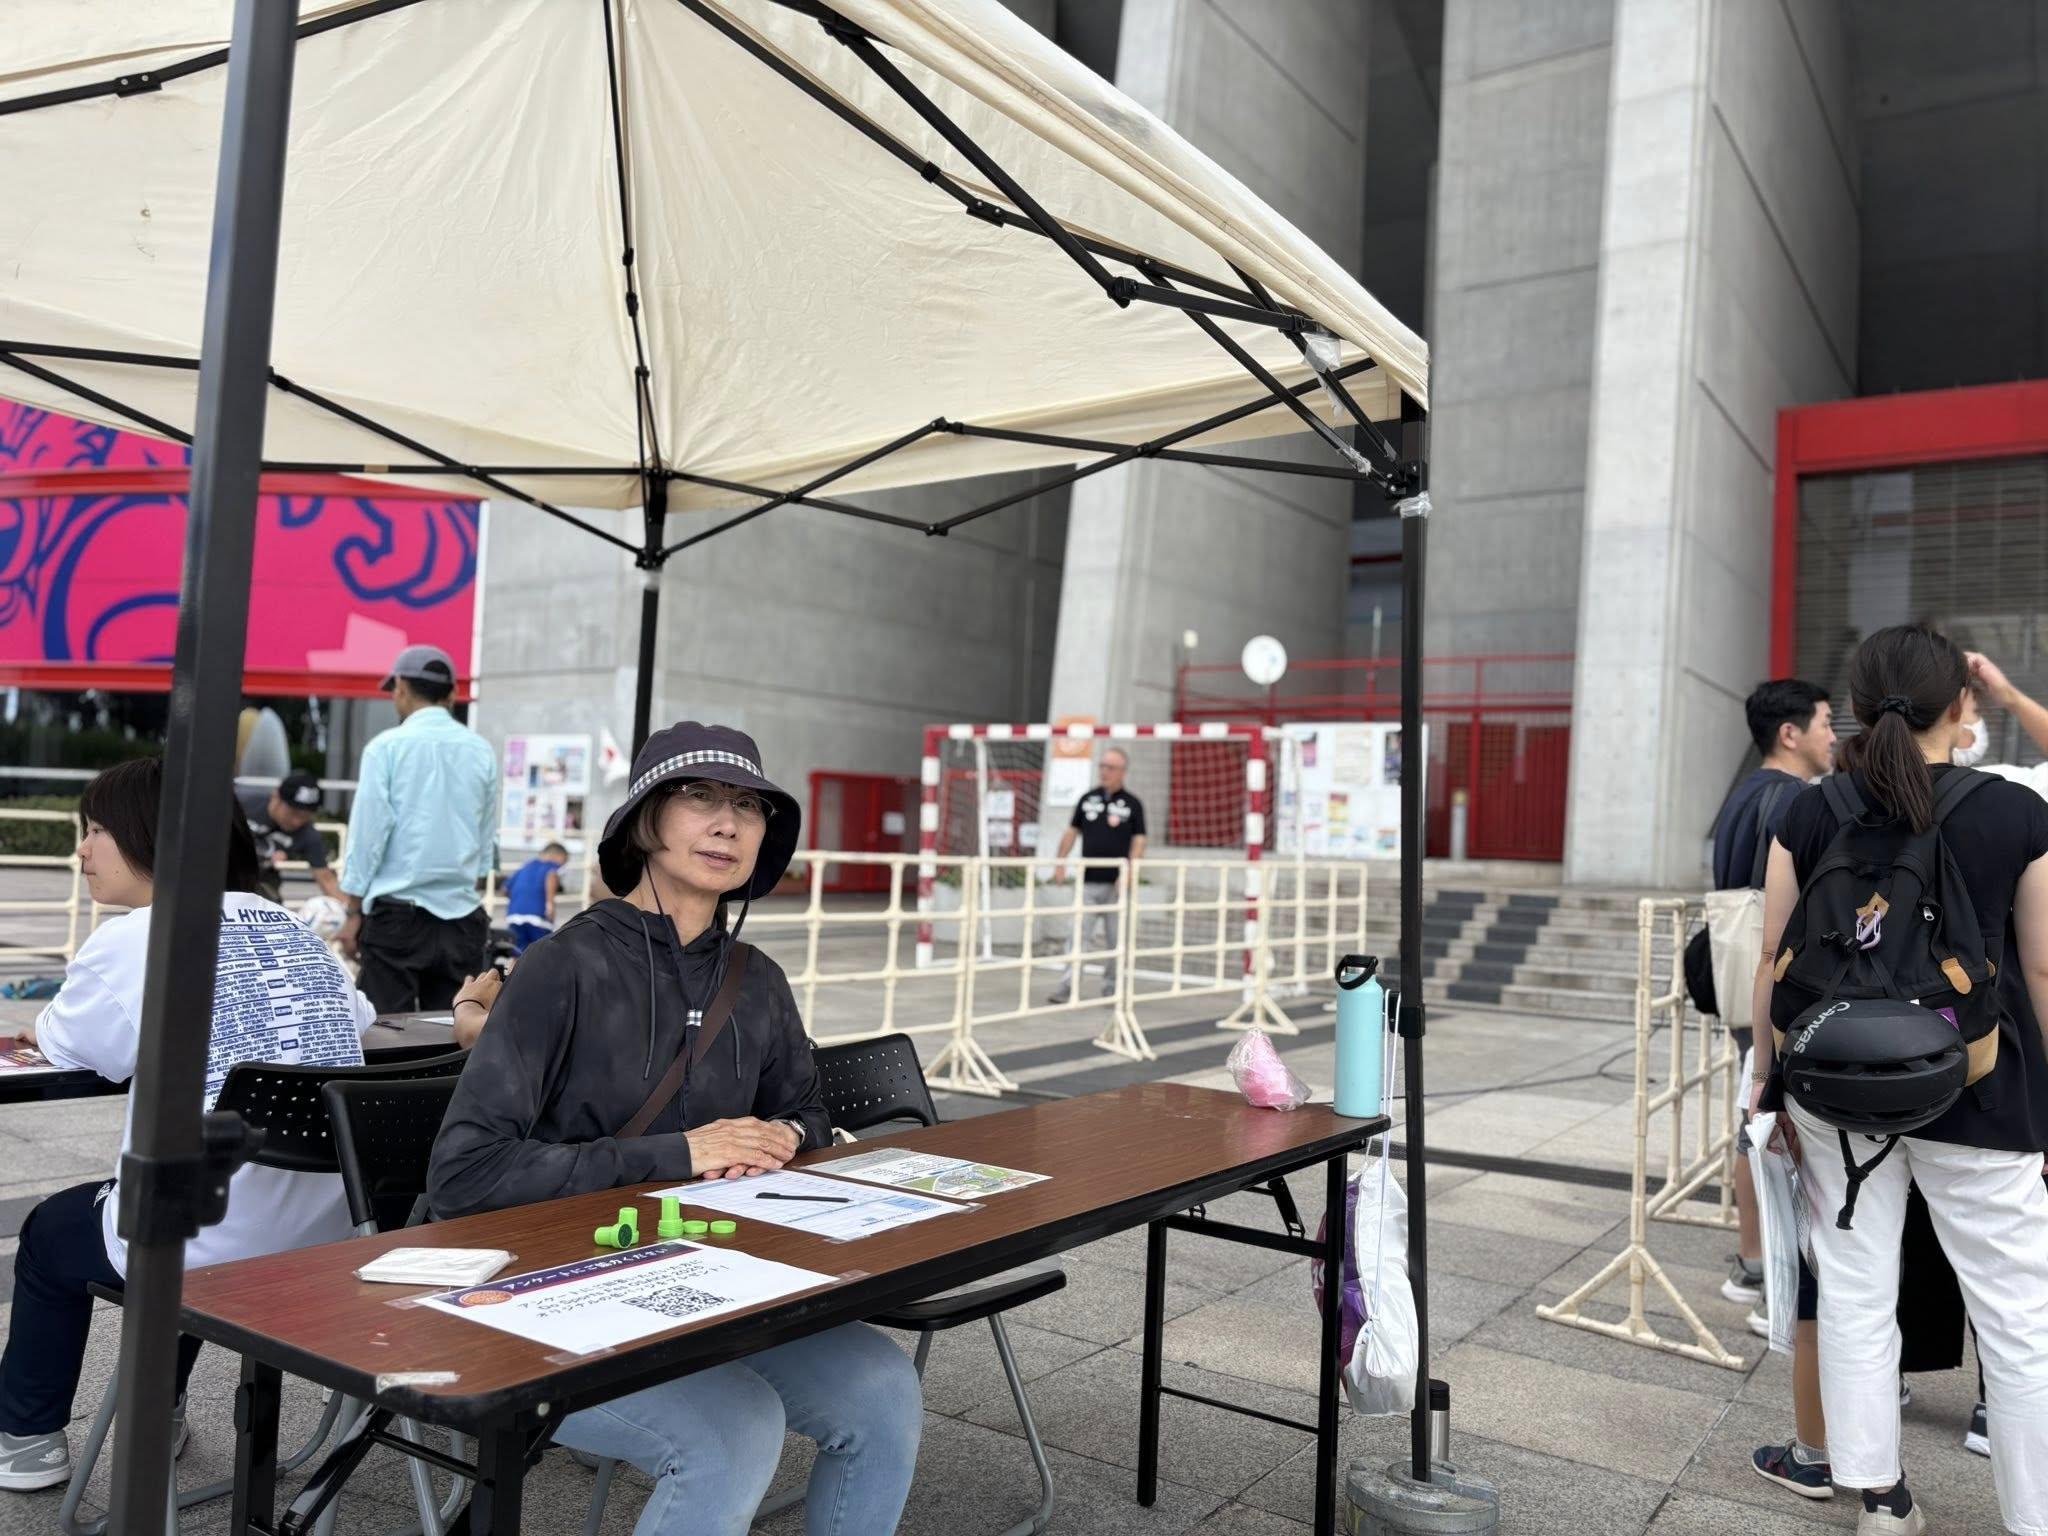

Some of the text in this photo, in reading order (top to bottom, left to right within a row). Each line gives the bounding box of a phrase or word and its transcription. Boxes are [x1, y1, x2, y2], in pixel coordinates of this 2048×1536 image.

[238, 908, 292, 923] HYOGO
[1794, 1001, 1851, 1054] Canvas
[501, 1248, 669, 1289] アンケートにご協力ください
